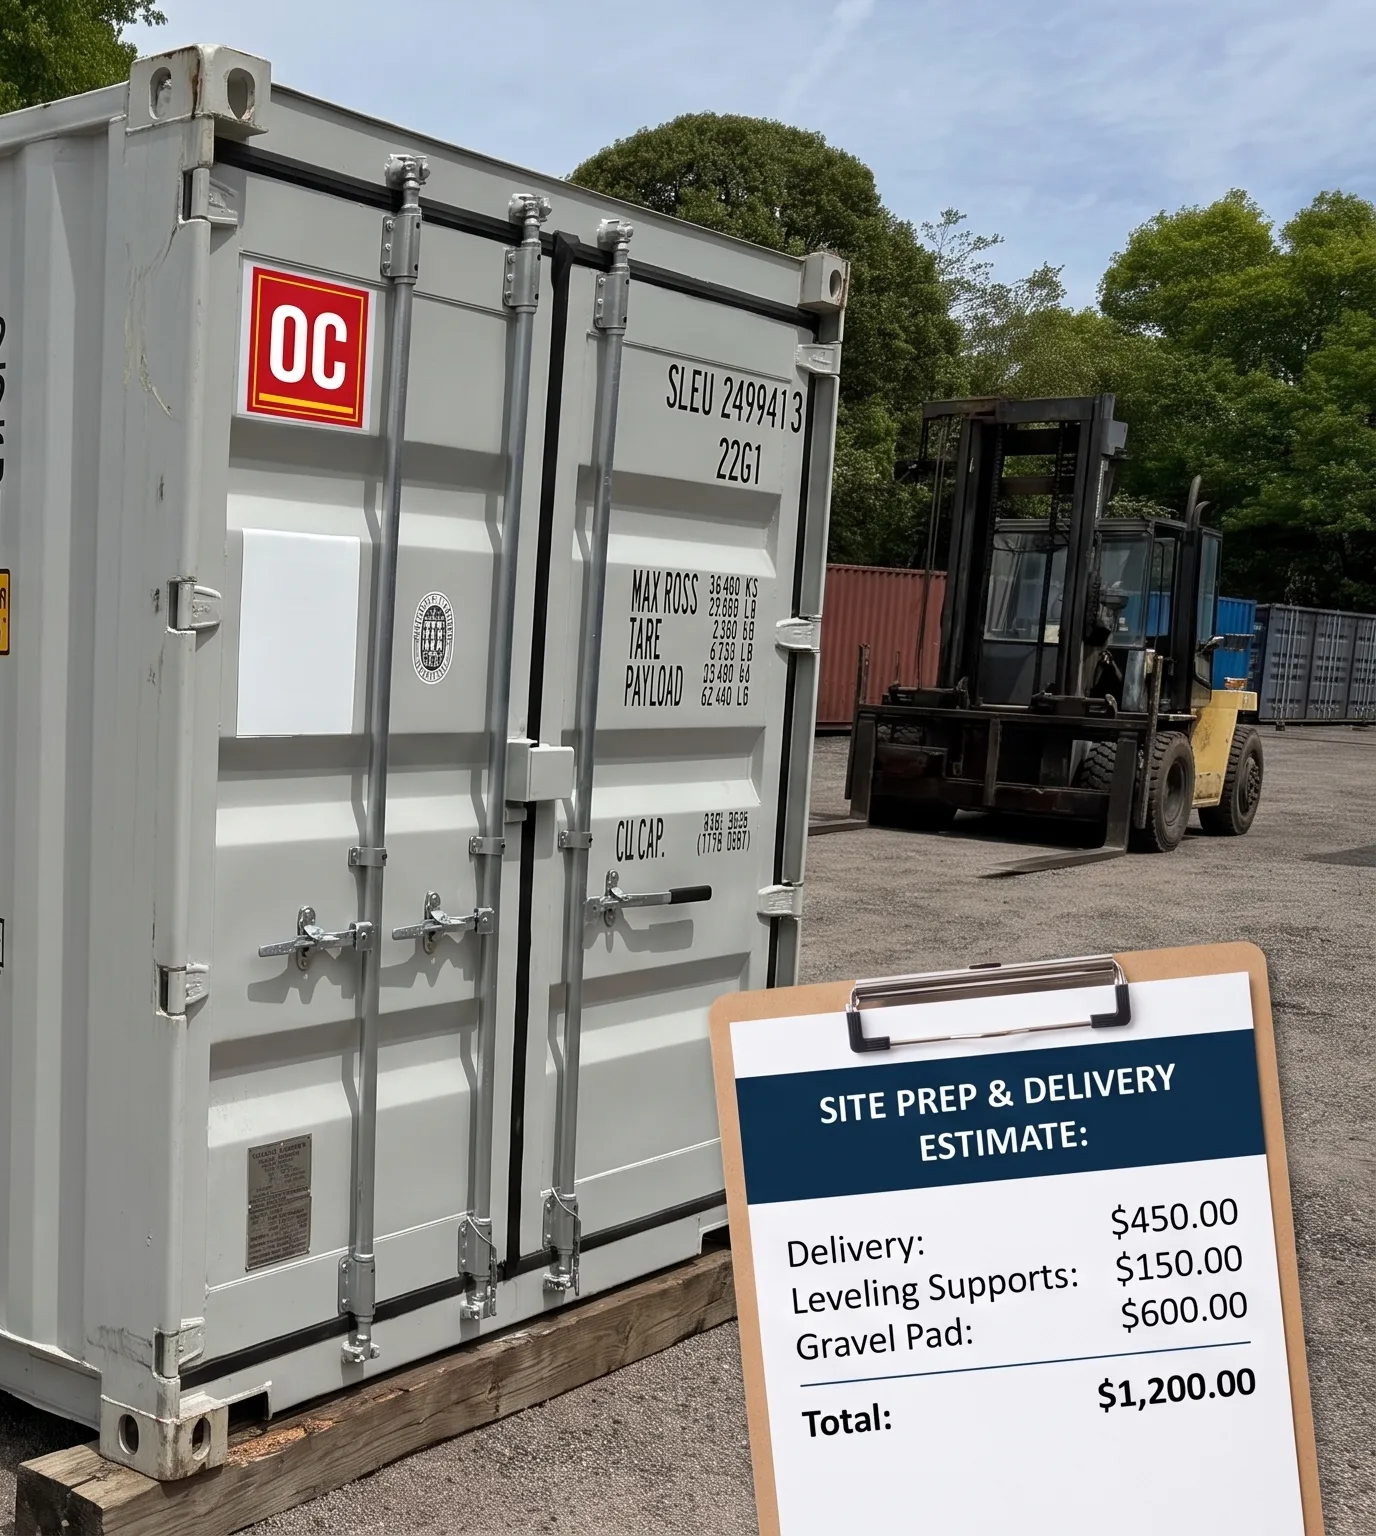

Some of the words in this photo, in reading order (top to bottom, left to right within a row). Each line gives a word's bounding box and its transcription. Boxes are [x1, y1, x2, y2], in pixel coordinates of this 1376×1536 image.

[269, 304, 348, 390] OC
[666, 364, 715, 416] SLEU
[720, 376, 803, 434] 2499413
[716, 437, 762, 485] 22G1
[631, 569, 661, 613] MAX
[663, 571, 699, 615] ROSS
[629, 617, 663, 660] TARE
[624, 664, 684, 707] PAYLOAD
[819, 1091, 887, 1124] SITE
[896, 1083, 977, 1117] PREP
[988, 1079, 1014, 1108] &
[1024, 1063, 1176, 1104] DELIVERY
[919, 1120, 1089, 1162] ESTIMATE:
[787, 1235, 925, 1269] Delivery:
[1111, 1197, 1238, 1241] $450.00
[792, 1278, 920, 1316] Leveling
[928, 1265, 1079, 1306] Supports:
[1116, 1244, 1243, 1288] $150.00
[796, 1323, 896, 1361] Gravel
[906, 1316, 973, 1352] Pad:
[1121, 1291, 1248, 1334] $600.00
[801, 1402, 892, 1438] Total:
[1097, 1367, 1256, 1414] $1,200.00
